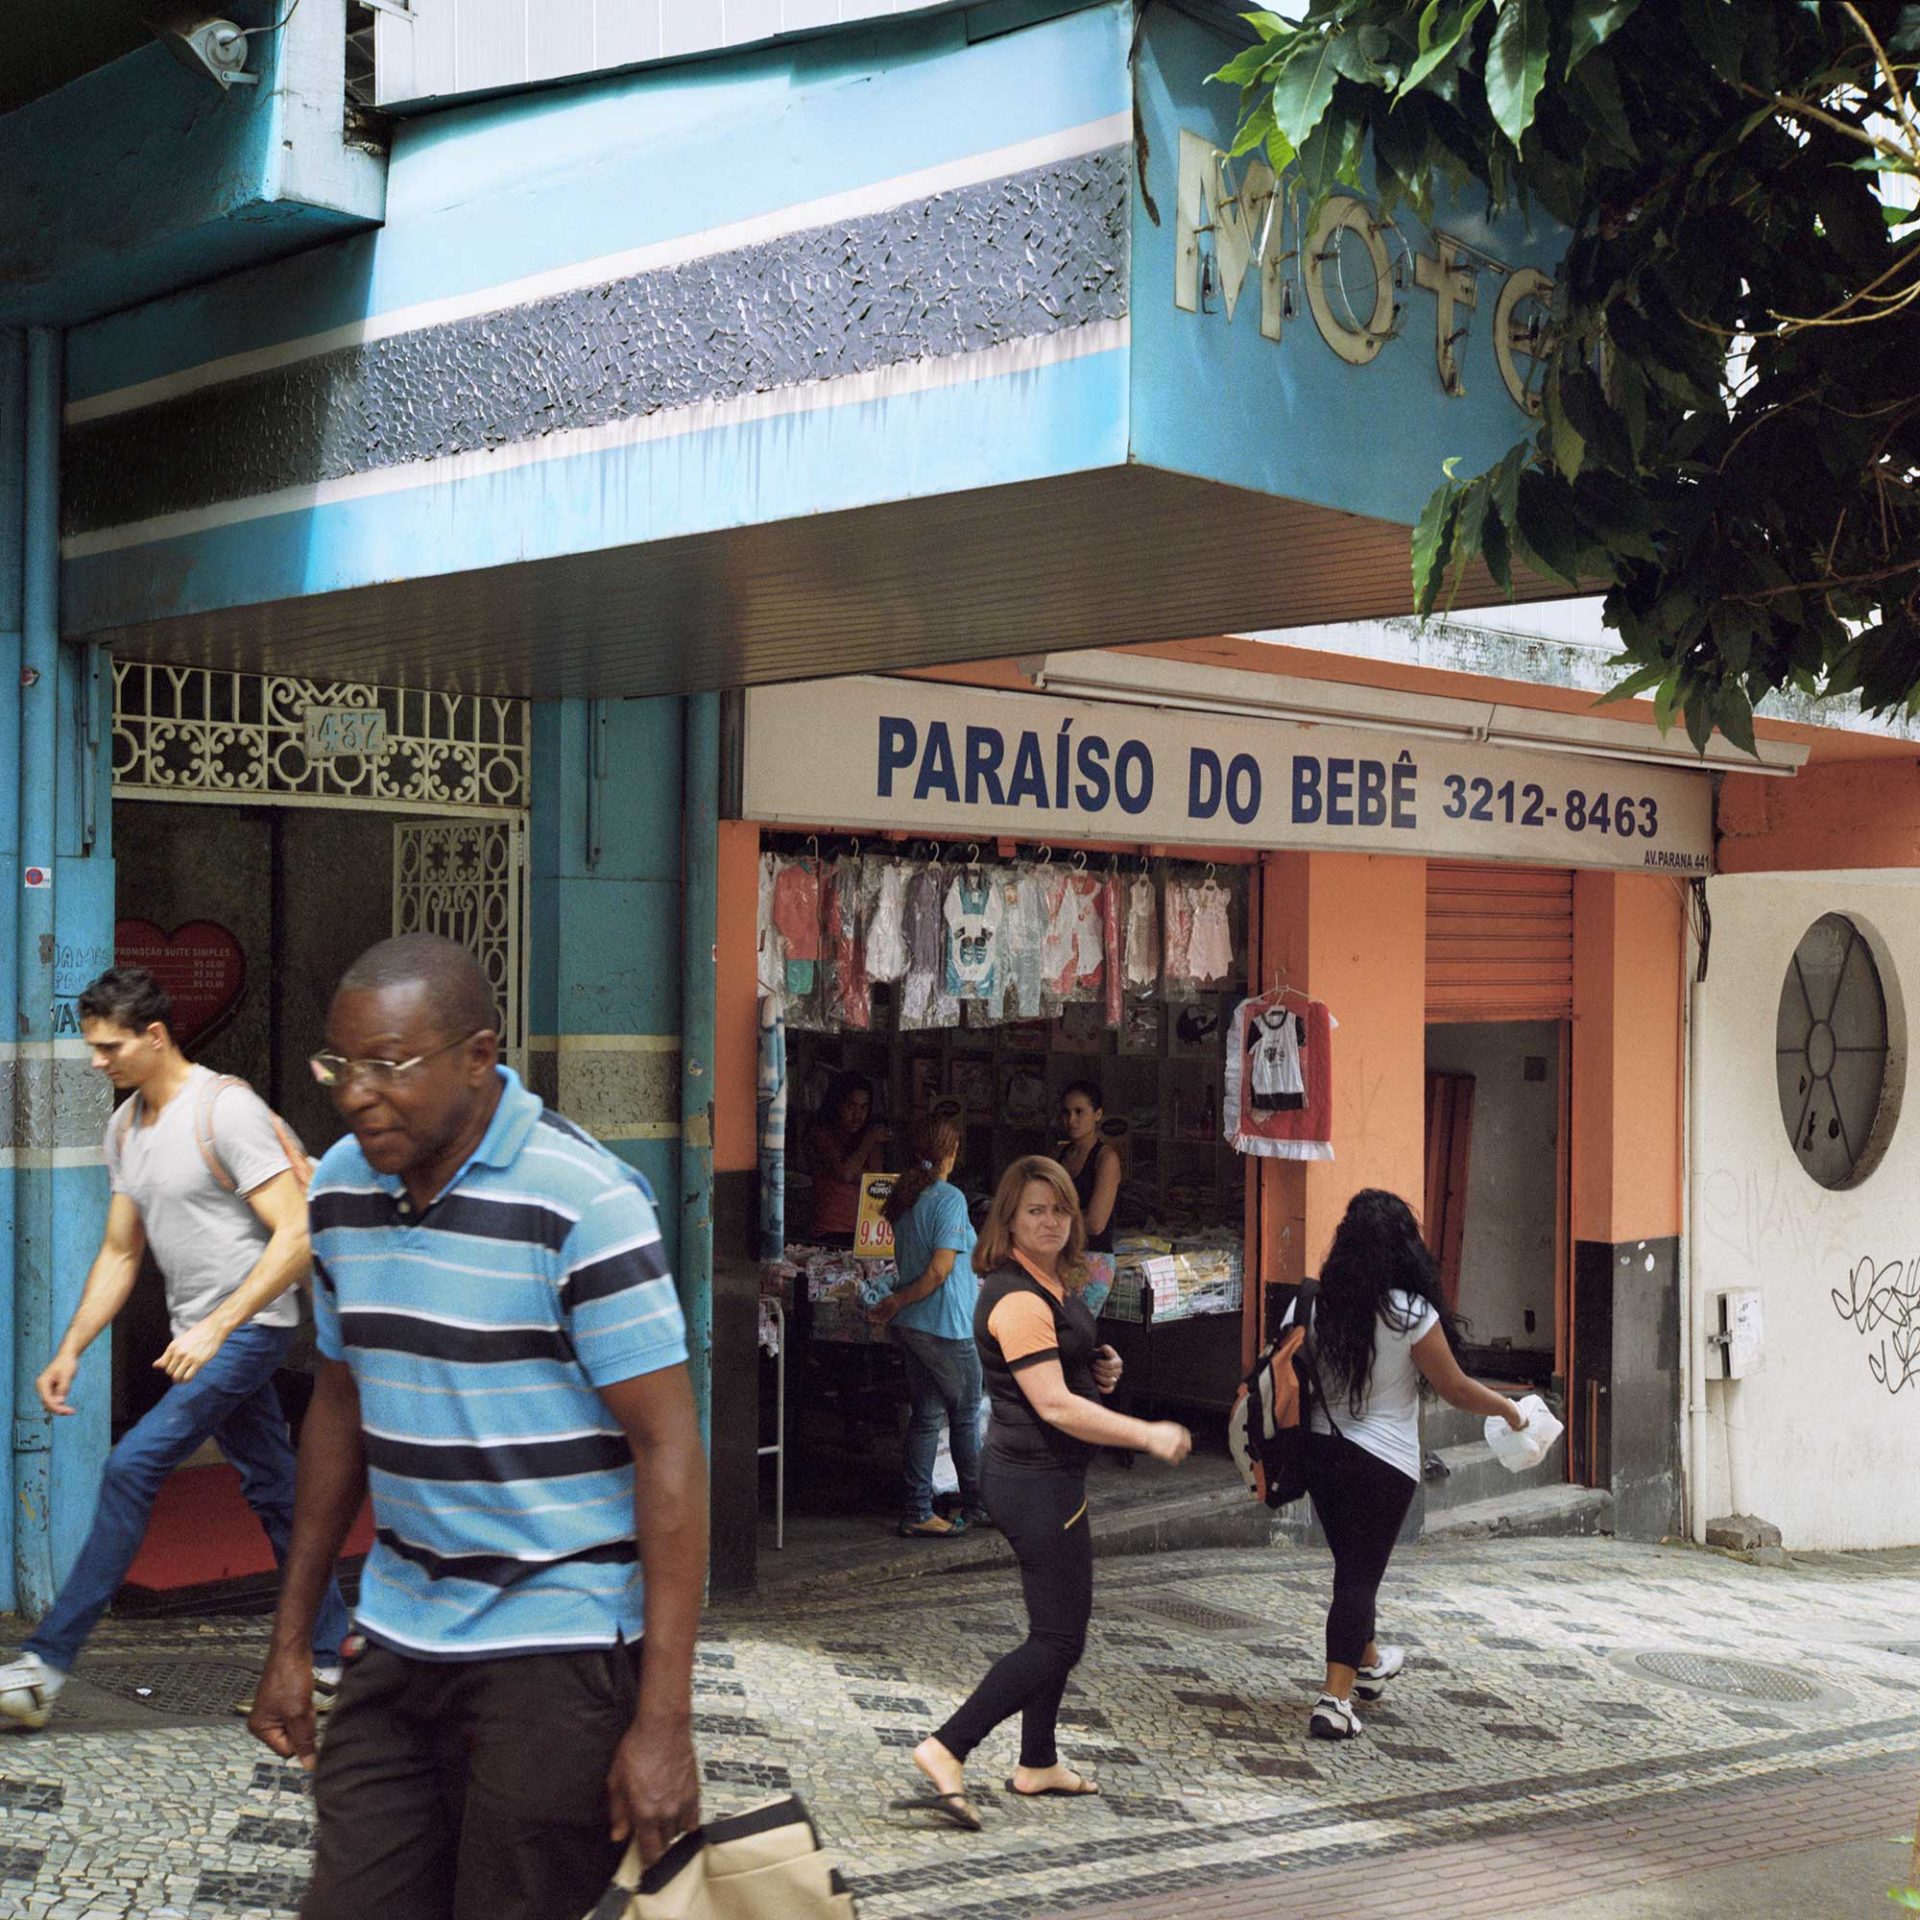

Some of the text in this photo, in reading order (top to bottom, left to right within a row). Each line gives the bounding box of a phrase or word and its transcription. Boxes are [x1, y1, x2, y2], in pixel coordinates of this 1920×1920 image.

[317, 712, 381, 752] 437
[877, 716, 1658, 838] PARAÍSO DO BEBÊ 3212-8463
[1695, 854, 1709, 869] 441
